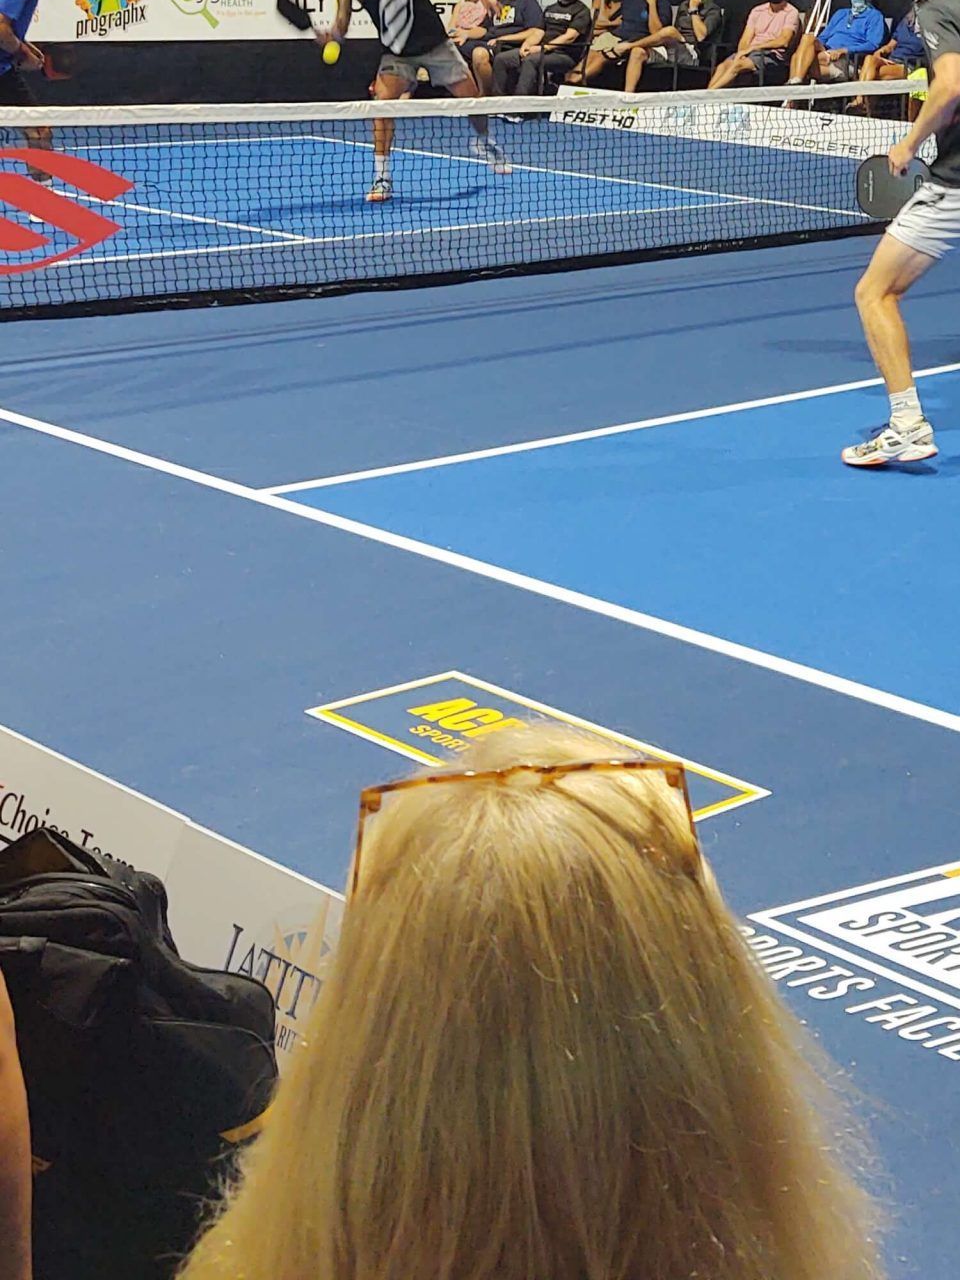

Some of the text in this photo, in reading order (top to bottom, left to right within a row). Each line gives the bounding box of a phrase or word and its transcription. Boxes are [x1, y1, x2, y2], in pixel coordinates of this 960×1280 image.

[76, 6, 146, 39] prographx
[562, 110, 635, 129] FAST 40
[769, 135, 871, 157] PADDLETEK
